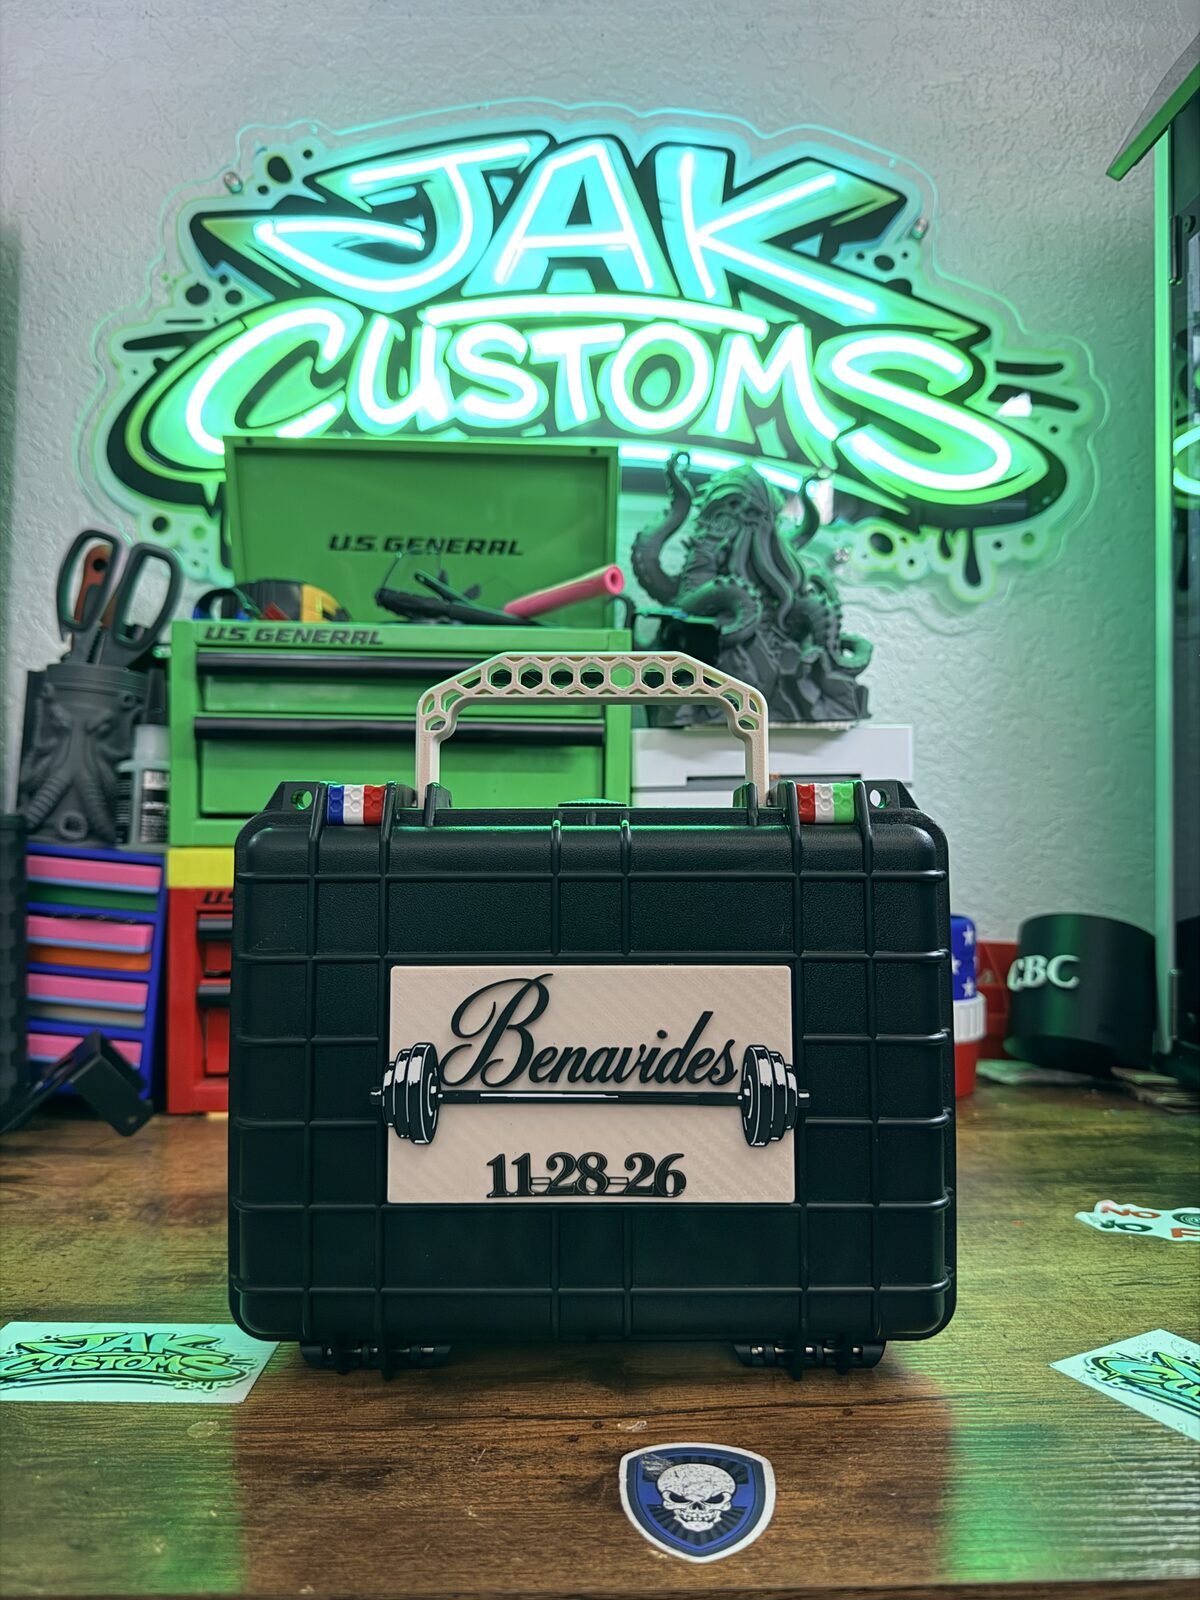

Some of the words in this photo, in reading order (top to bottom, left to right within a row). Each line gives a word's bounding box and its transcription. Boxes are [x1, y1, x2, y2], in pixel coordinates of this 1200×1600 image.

[198, 130, 988, 342] JAK
[384, 535, 523, 556] GENERAL
[254, 627, 384, 646] GENERAL
[438, 973, 738, 1087] Benavides
[486, 1152, 687, 1198] 11-28-26
[18, 1332, 235, 1357] JAK
